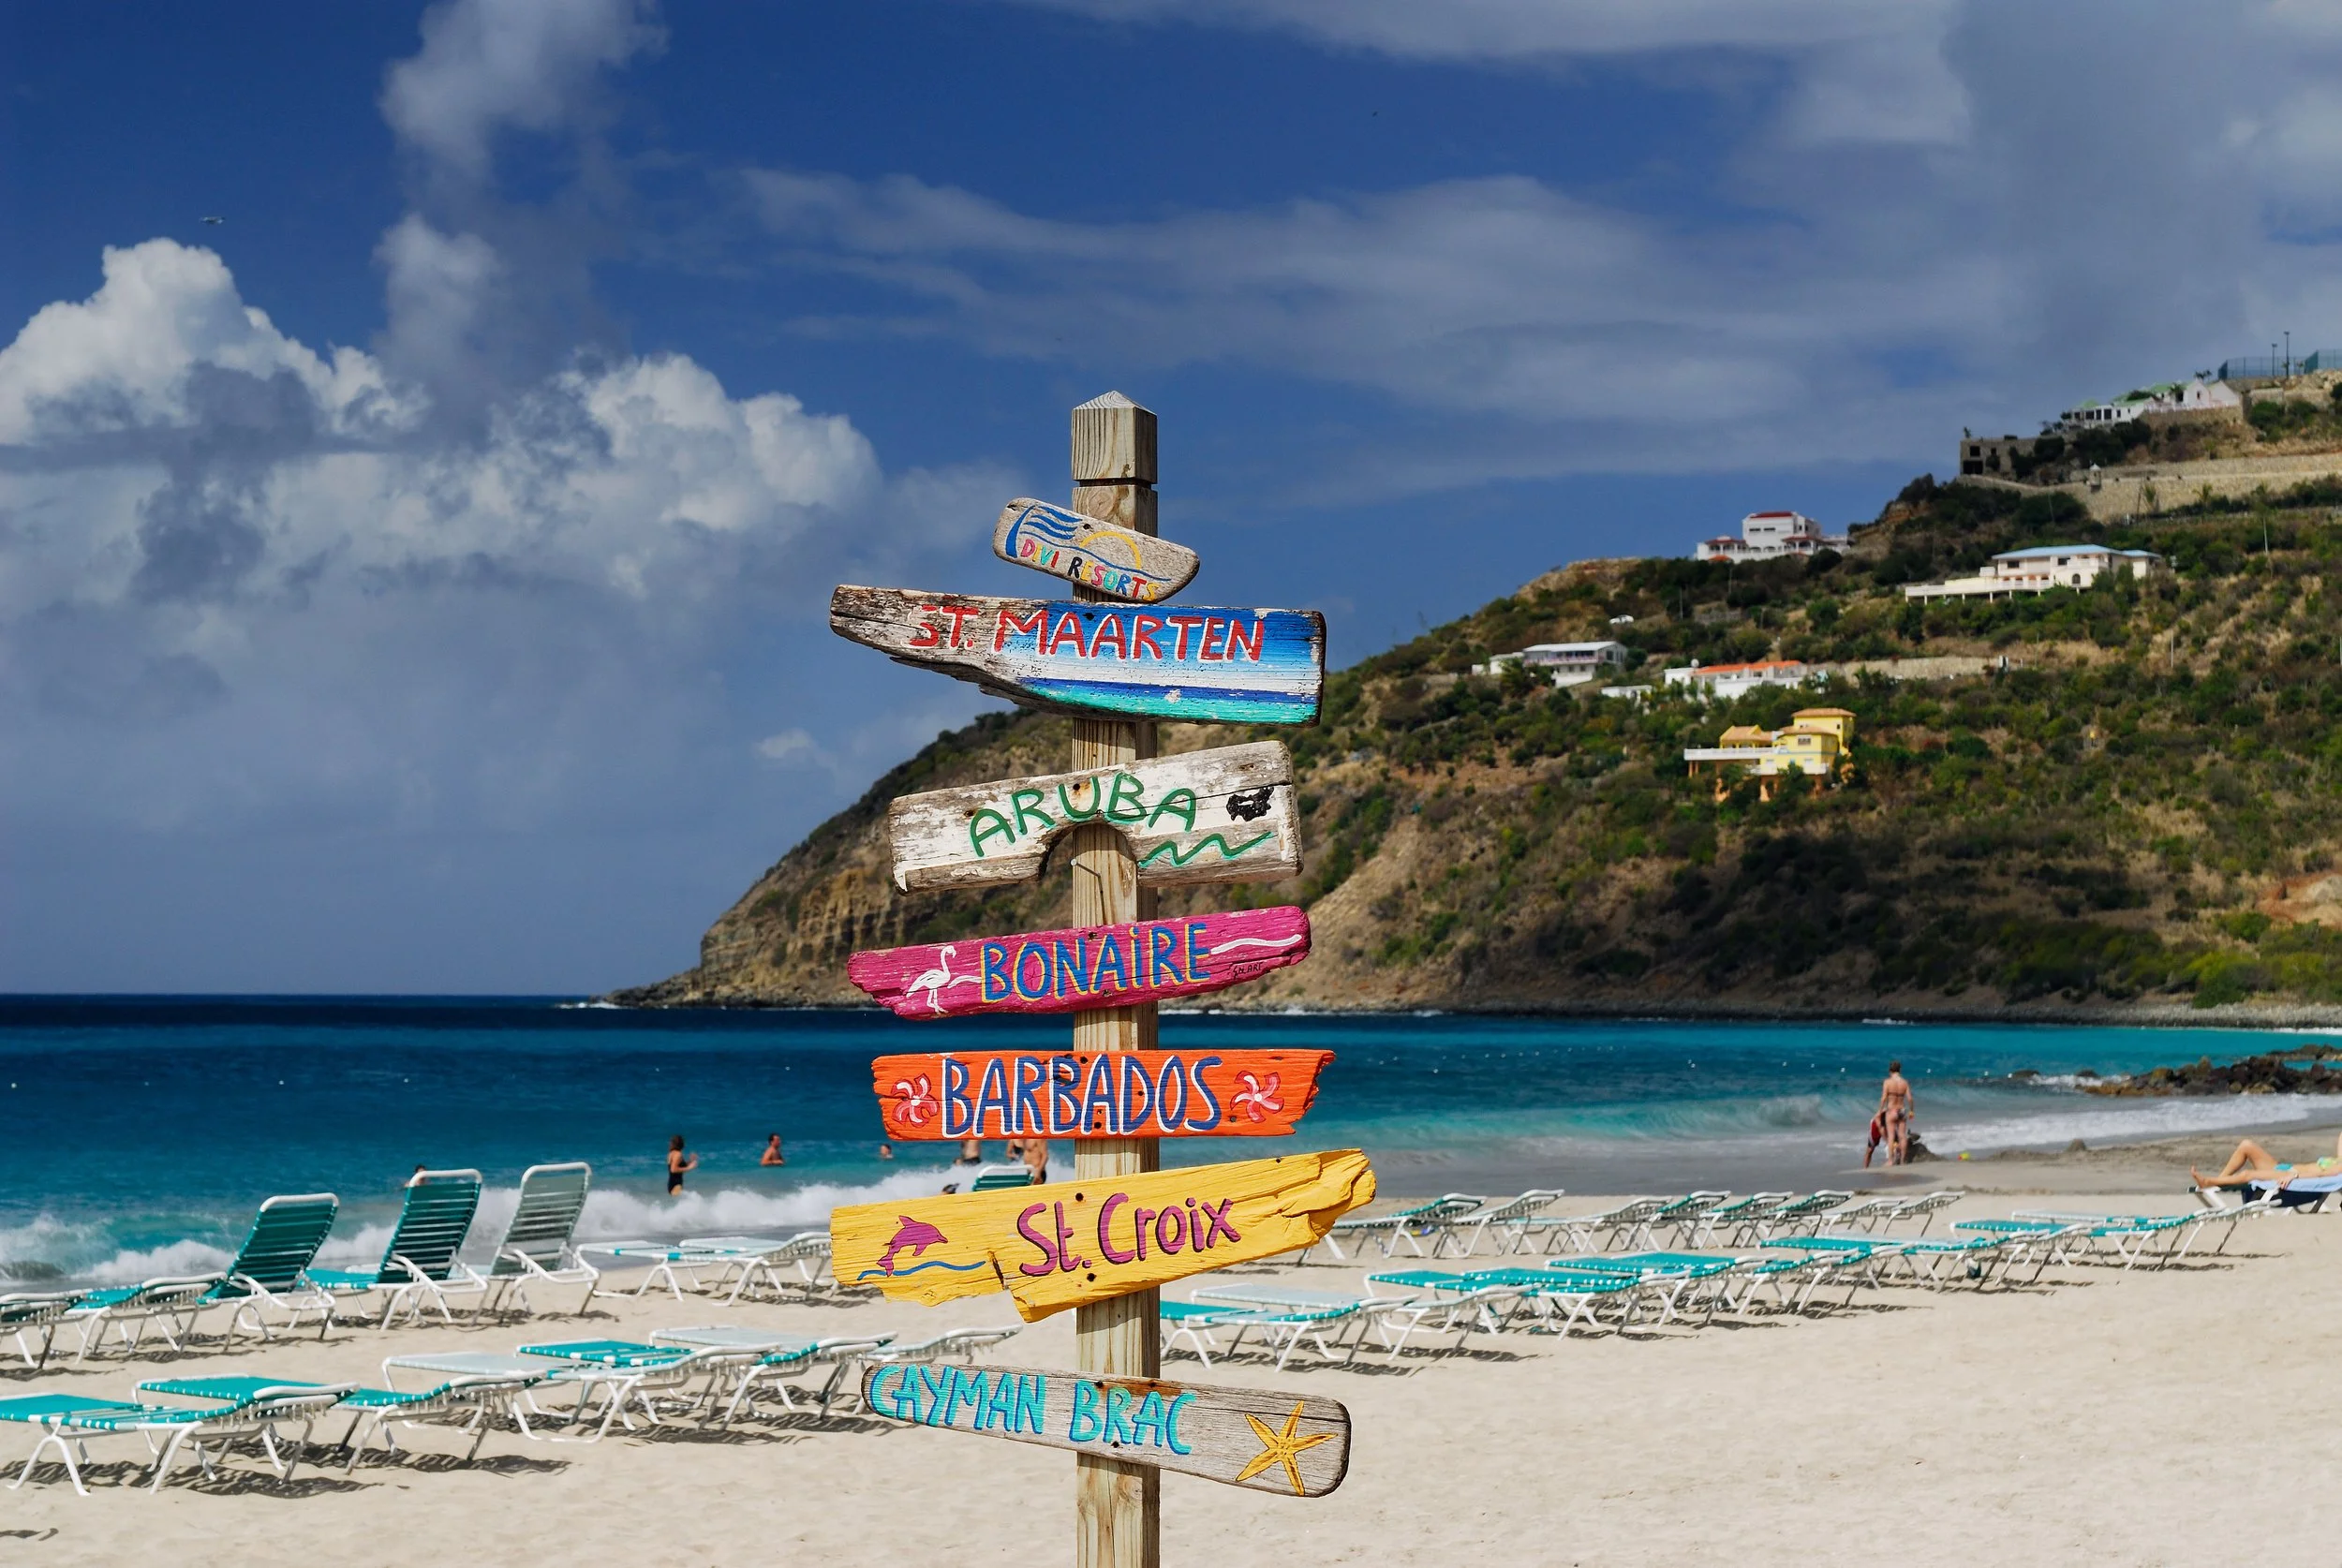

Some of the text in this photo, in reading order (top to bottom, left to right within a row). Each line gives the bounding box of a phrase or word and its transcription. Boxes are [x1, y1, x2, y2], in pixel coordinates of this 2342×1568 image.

[1020, 539, 1161, 601] DIVI RESORTS
[900, 604, 1264, 661] ST. MAARTEN
[970, 773, 1196, 857] ARUBA
[941, 1053, 1223, 1138] BARBADOS
[1016, 1192, 1241, 1277] St. Croix
[869, 1364, 1196, 1456] CAYMAN BRAC
